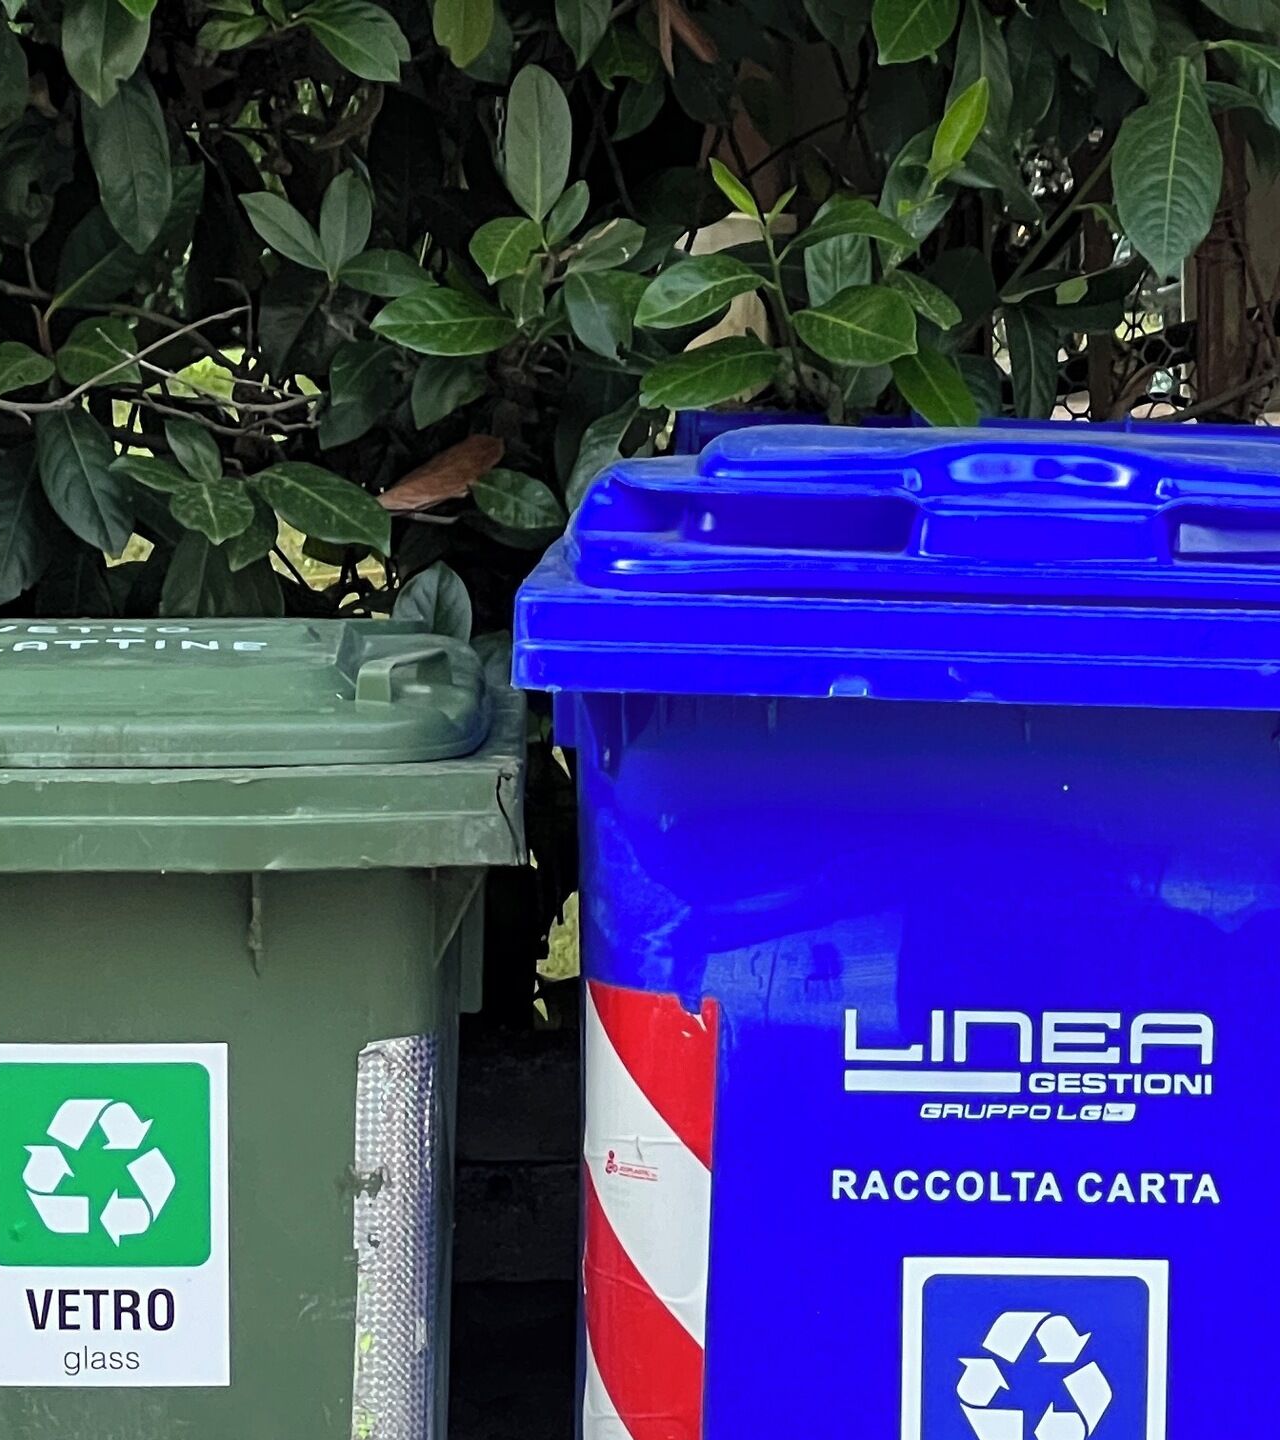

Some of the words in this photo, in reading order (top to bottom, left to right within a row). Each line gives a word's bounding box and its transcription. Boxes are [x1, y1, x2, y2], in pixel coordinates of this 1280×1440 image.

[844, 1008, 1214, 1065] LINEA
[1028, 1072, 1213, 1095] GESTIONI
[920, 1103, 1051, 1120] GRUPPO
[831, 1168, 1063, 1202] RACCOLTA
[1077, 1171, 1221, 1204] CARTA
[25, 1288, 176, 1332] VETRO
[63, 1345, 140, 1376] glass
